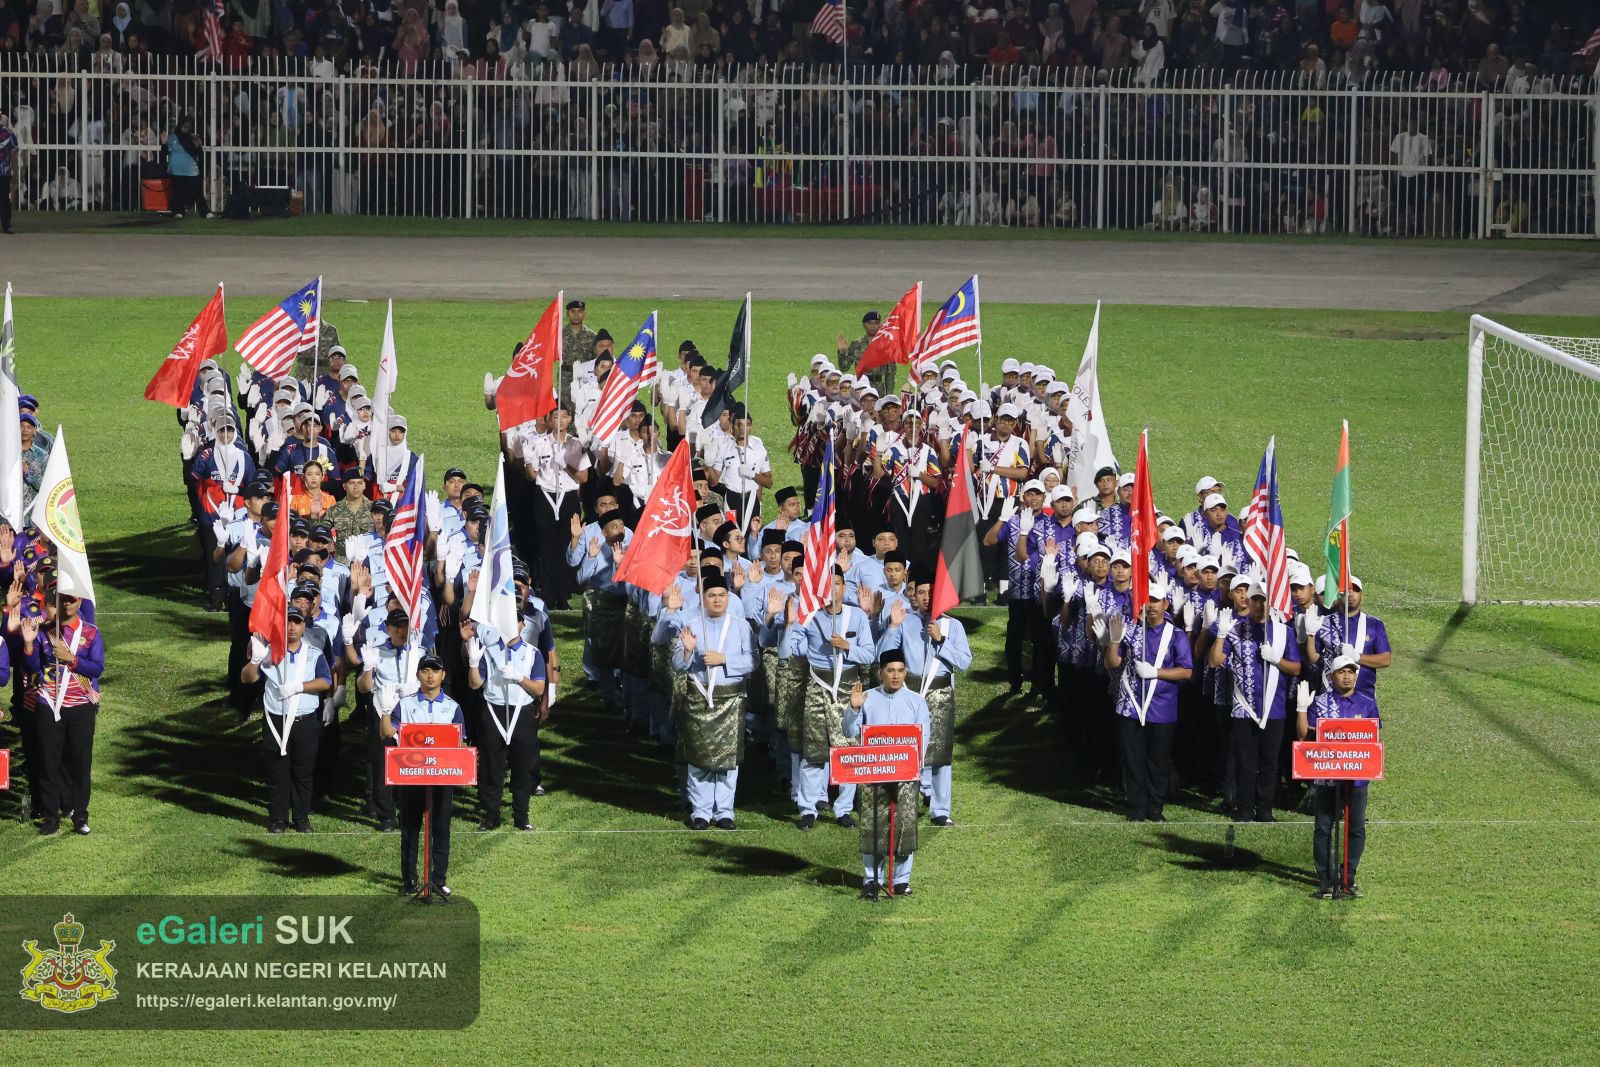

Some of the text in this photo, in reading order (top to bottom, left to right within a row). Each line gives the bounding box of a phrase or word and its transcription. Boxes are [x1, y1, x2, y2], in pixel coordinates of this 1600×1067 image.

[868, 736, 917, 745] KONTINJEN JAJAHAN
[1324, 732, 1346, 740] MAJLIS
[424, 737, 435, 745] JPS
[840, 752, 909, 764] KONTINJEN JAJAHAN
[1306, 750, 1370, 759] MAJLIS DAERAH
[424, 757, 437, 765] JPS
[854, 765, 896, 775] KOTA BHARU
[1313, 762, 1362, 770] KUALA KRAI
[399, 767, 463, 776] NEGERI KELANTAN
